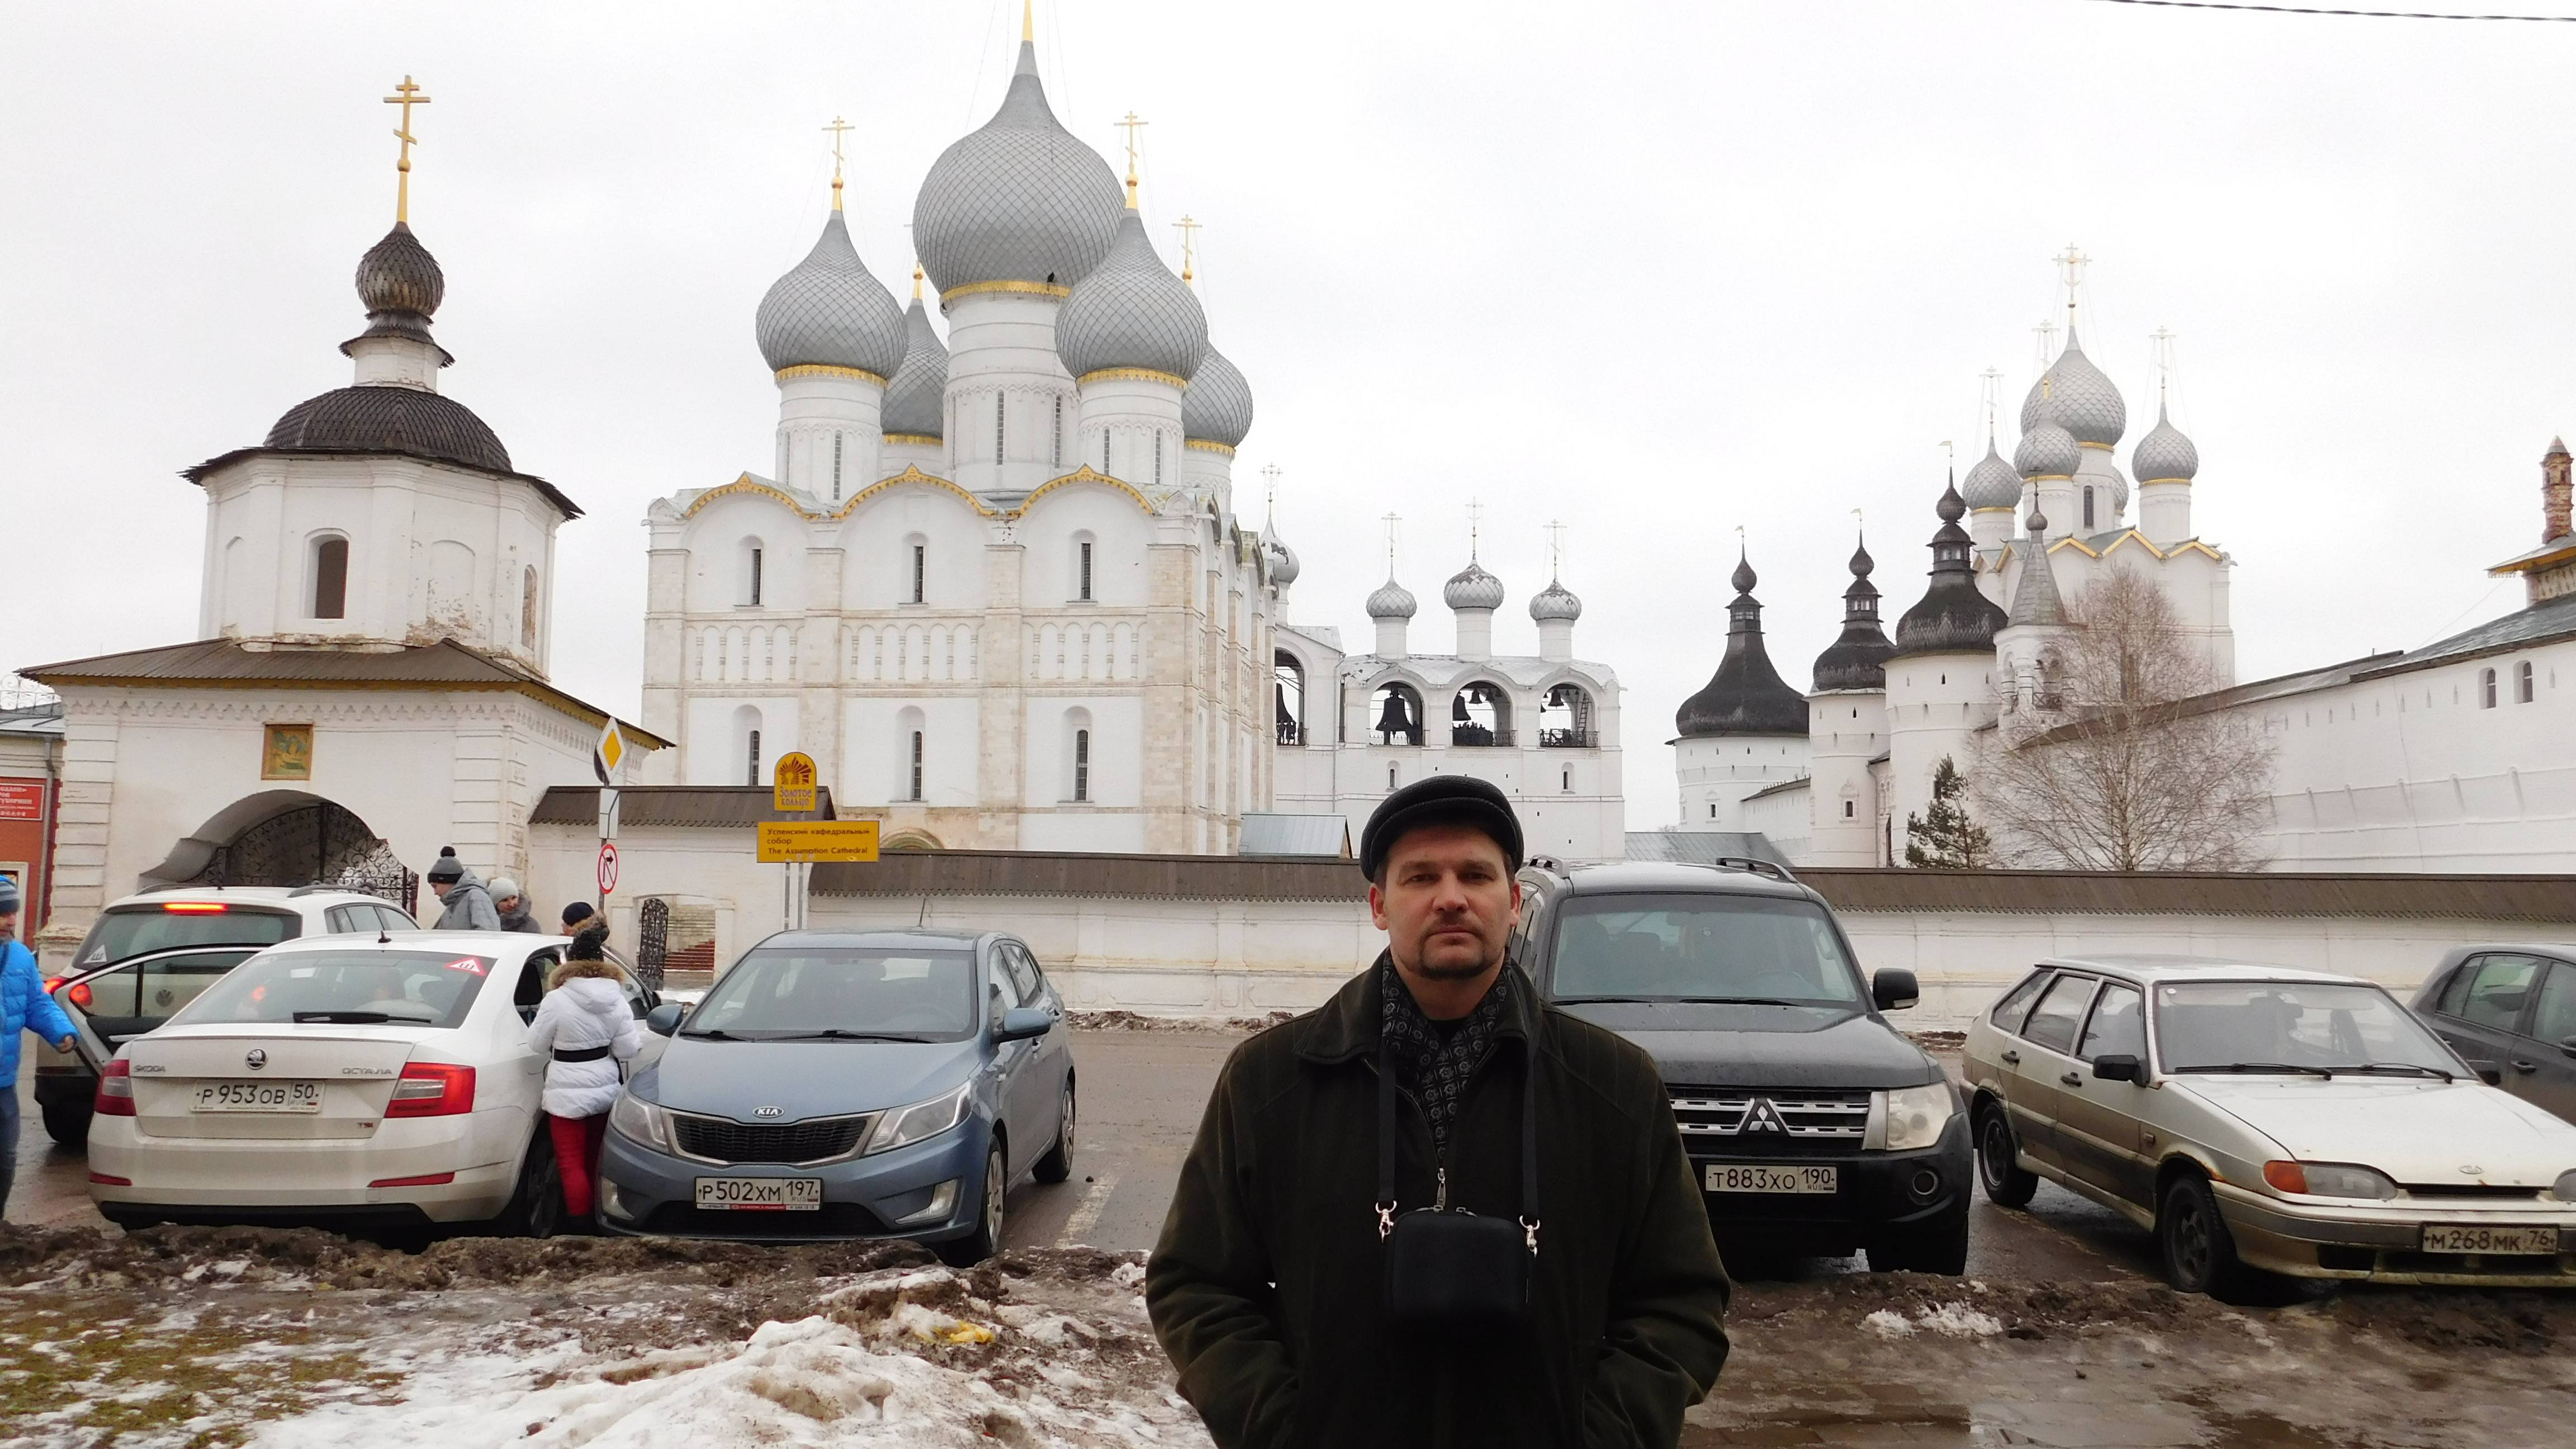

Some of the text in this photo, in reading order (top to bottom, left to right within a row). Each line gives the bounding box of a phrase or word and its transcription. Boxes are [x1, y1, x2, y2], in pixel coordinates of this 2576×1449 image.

[293, 1084, 315, 1098] 50
[1801, 1168, 1831, 1184] 190
[786, 1181, 815, 1196] 197
[2529, 1230, 2549, 1246] 76
